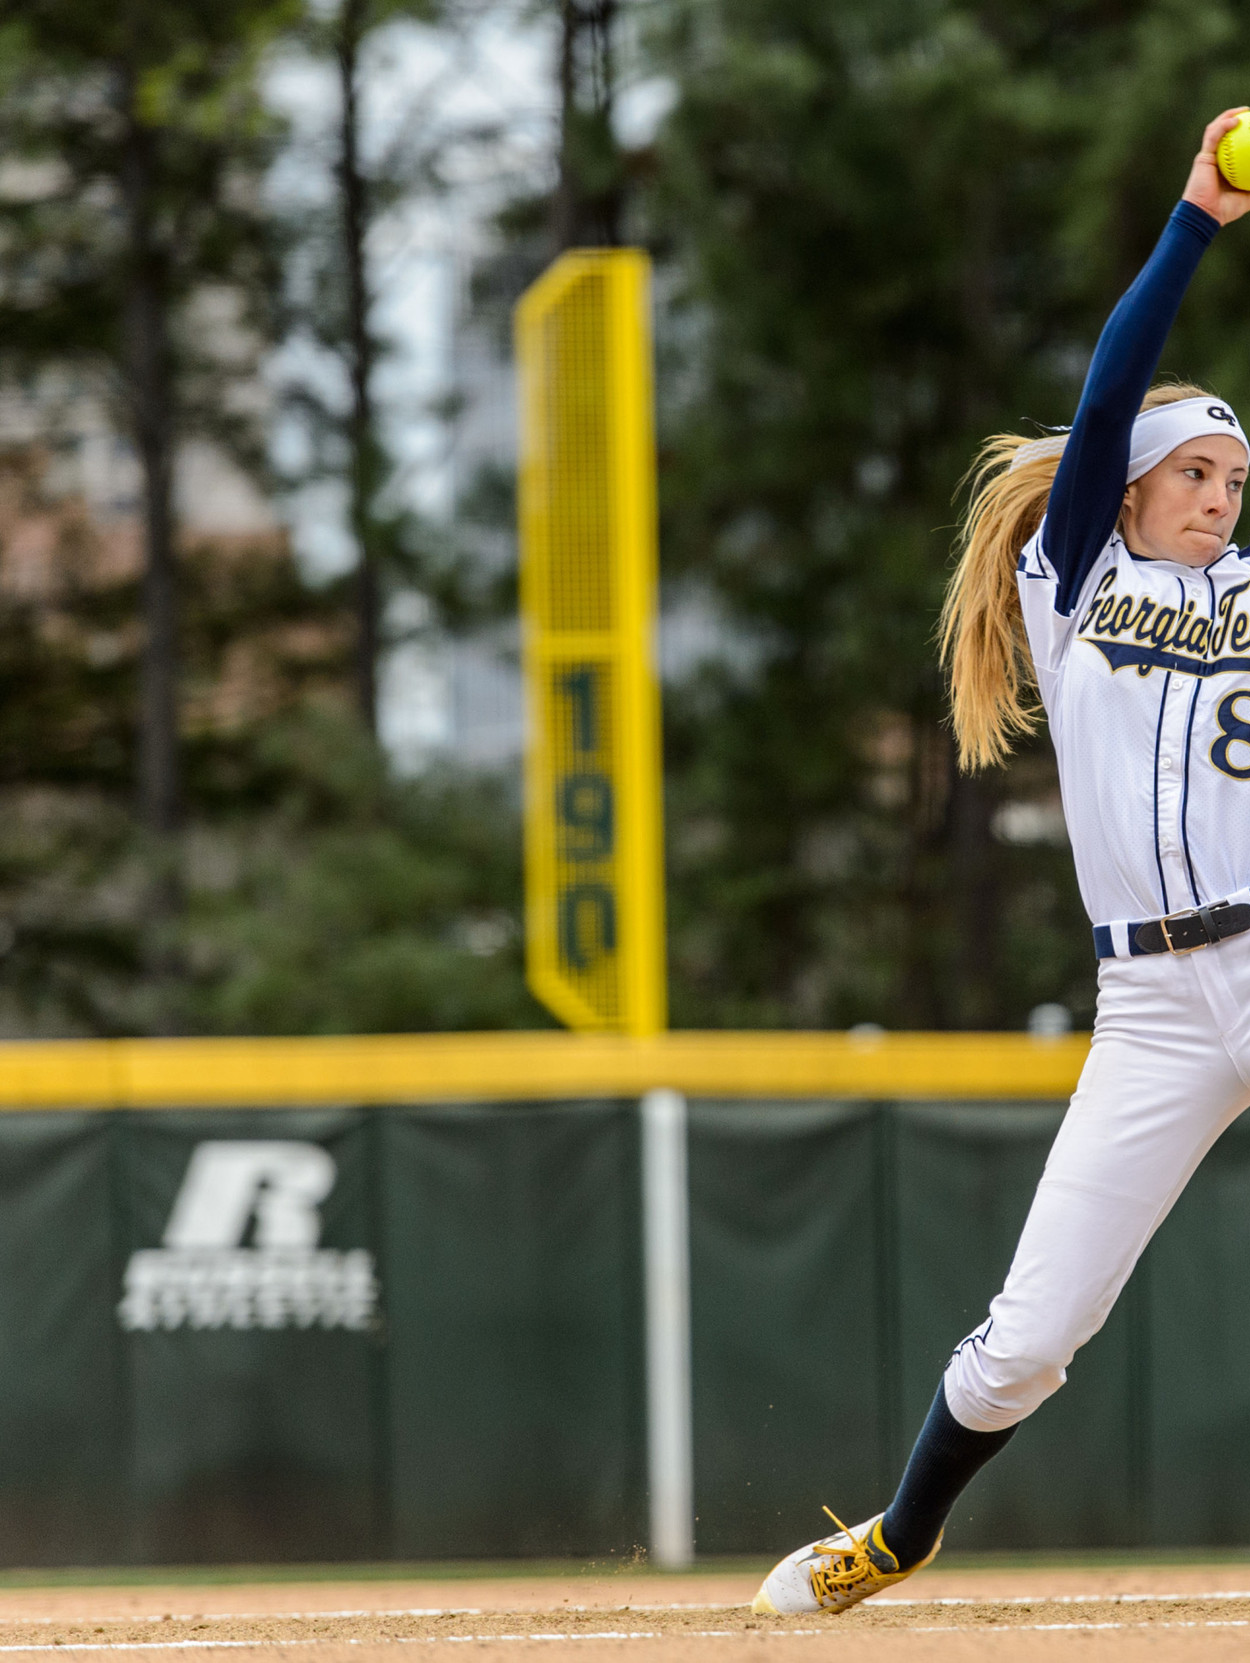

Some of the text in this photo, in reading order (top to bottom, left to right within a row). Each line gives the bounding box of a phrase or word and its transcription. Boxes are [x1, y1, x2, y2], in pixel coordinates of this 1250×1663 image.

[1077, 566, 1213, 679] Georgia
[553, 664, 617, 972] 190
[162, 1139, 338, 1249] R
